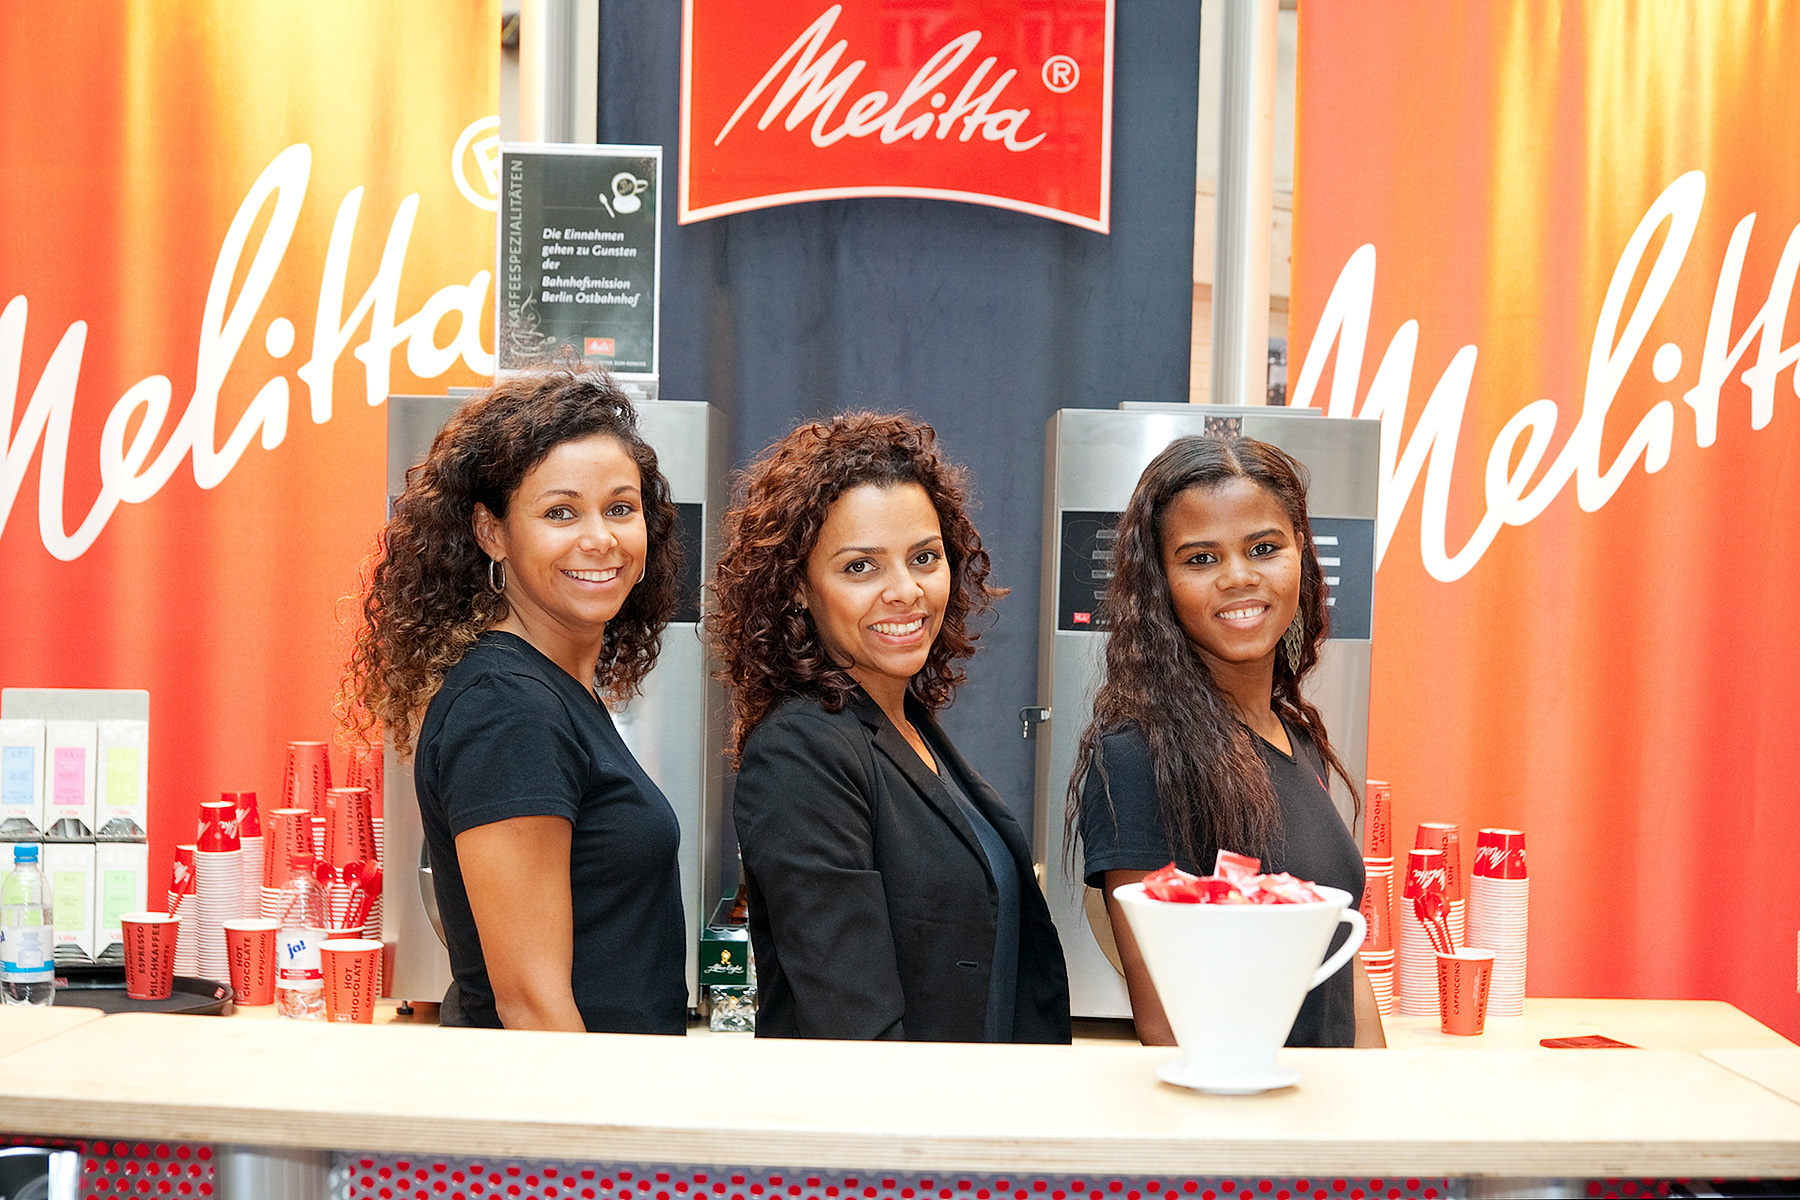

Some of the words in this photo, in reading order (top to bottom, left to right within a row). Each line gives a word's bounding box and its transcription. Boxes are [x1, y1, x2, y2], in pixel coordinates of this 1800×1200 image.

[714, 4, 1046, 151] Melitta
[508, 160, 523, 328] KAFFEESPEZIALITÄTEN
[542, 243, 574, 257] gehen
[576, 246, 590, 256] zu
[592, 244, 637, 257] Gunsten
[543, 228, 561, 239] Die
[564, 228, 624, 241] Einnahmen
[542, 258, 560, 270] der
[542, 275, 630, 291] Bahnhofsmission
[542, 291, 573, 303] Berlin
[575, 292, 641, 308] Ostbahnhof
[1289, 170, 1800, 582] Melitt
[1371, 793, 1382, 854] CHOCOLATE
[137, 925, 146, 974] ESPRESSO
[150, 923, 160, 997] MILCHKAFFEE
[243, 937, 251, 997] CHOCOLATE
[257, 933, 267, 986] CAPPUCCINO
[287, 940, 306, 959] ja!
[344, 967, 352, 989] HOT
[351, 957, 362, 1021] CHOCOLATE
[365, 953, 375, 1008] CAPPUCCINO
[1440, 964, 1448, 1025] CHOCOLATE
[1453, 961, 1461, 1015] CAPPUCCINO
